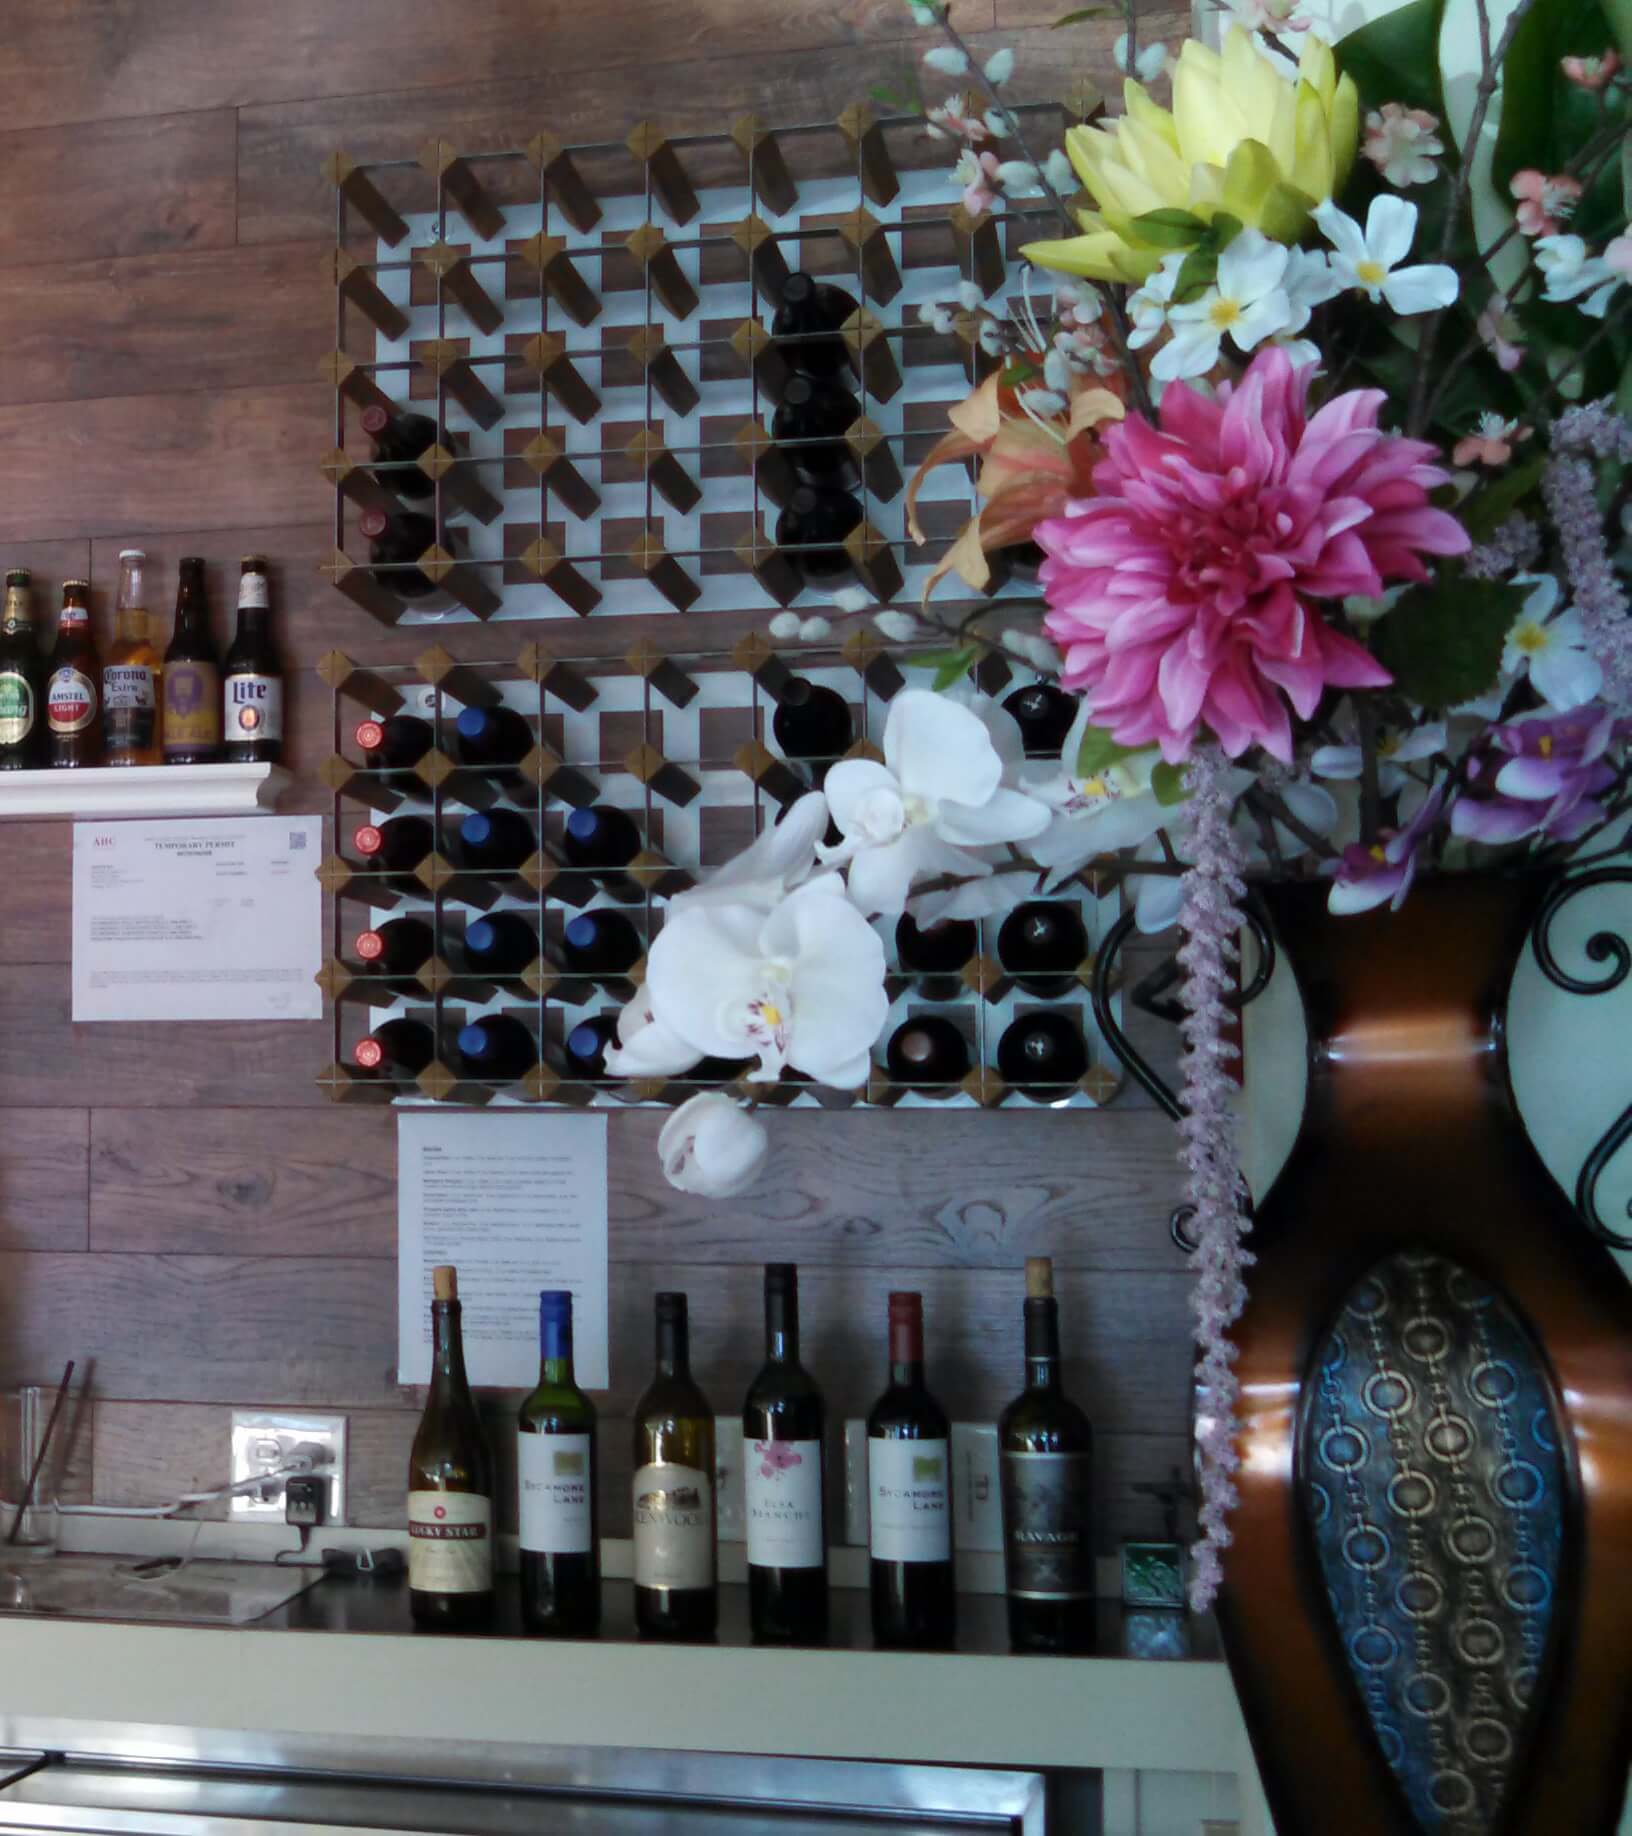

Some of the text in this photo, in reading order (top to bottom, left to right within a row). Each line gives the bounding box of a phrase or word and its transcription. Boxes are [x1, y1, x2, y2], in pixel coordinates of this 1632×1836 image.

[105, 668, 146, 682] Corona
[52, 692, 84, 701] AMSTEL
[233, 681, 267, 705] Lite
[54, 703, 80, 713] LIGHT
